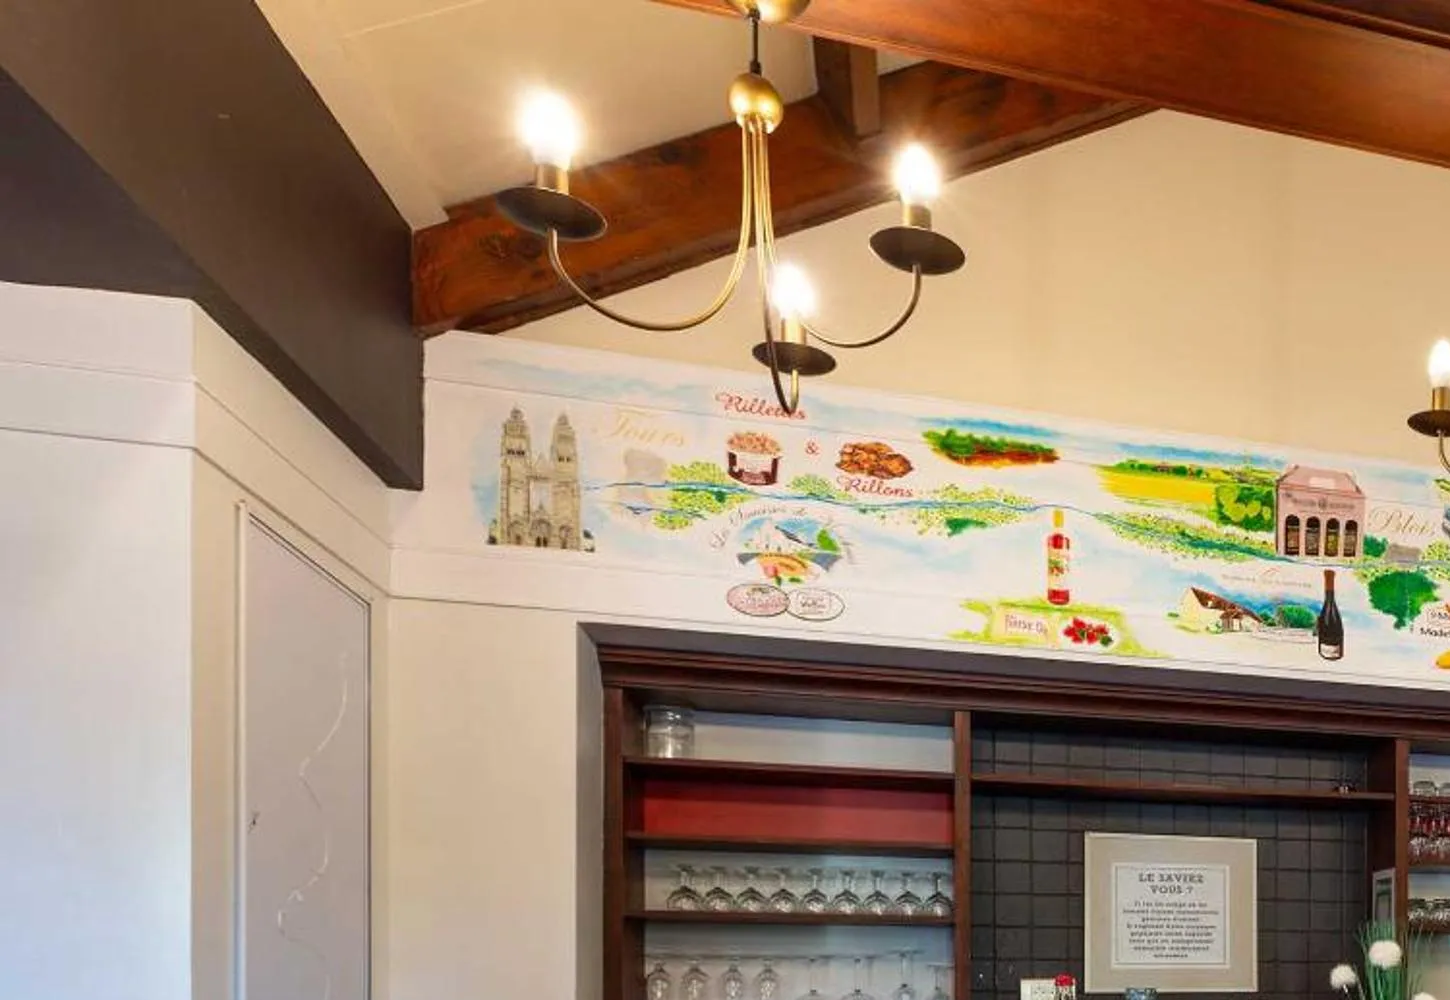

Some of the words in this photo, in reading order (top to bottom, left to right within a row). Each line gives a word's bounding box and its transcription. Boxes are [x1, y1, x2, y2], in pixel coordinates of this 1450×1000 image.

[606, 407, 685, 447] Tours
[804, 441, 820, 455] &
[837, 476, 914, 497] Rillons
[1138, 873, 1155, 883] LE
[1159, 873, 1204, 884] SAVIEZ
[1149, 885, 1183, 895] VOUS
